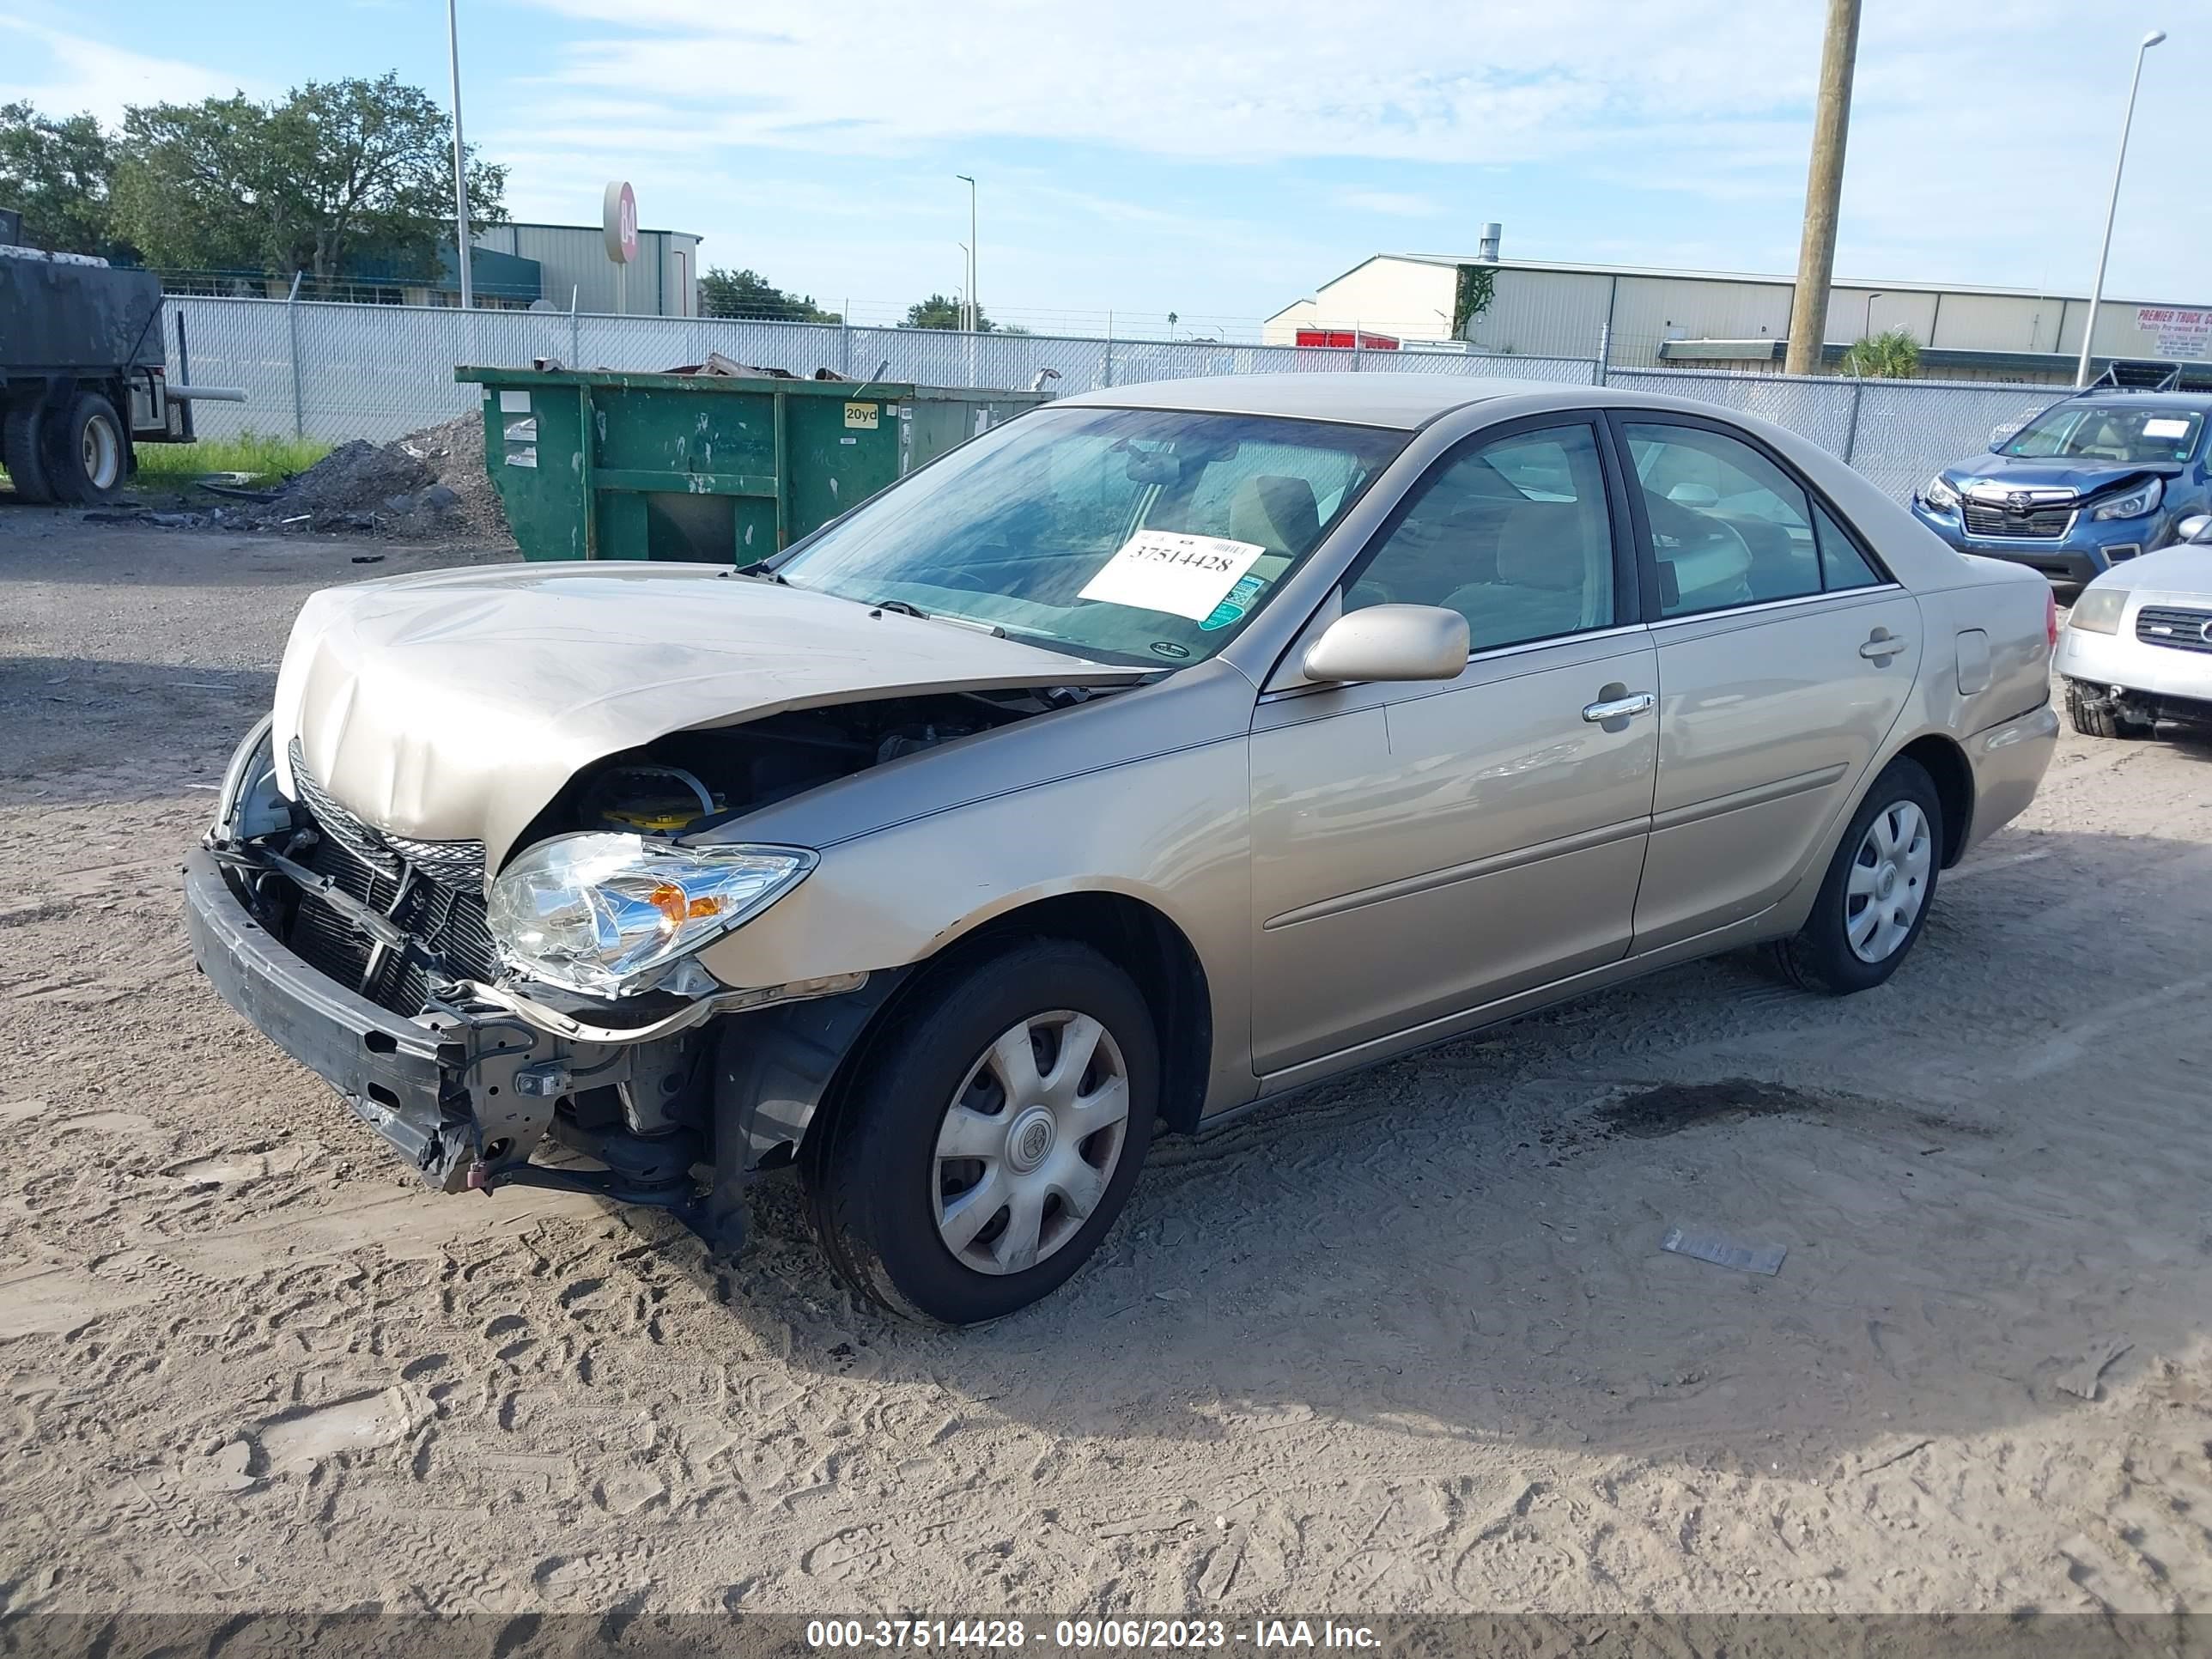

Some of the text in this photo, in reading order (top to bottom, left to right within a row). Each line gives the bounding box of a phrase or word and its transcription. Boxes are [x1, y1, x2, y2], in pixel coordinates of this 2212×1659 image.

[621, 199, 635, 246] 84
[2137, 309, 2175, 323] PREMIER
[2177, 311, 2203, 325] TRUCK
[846, 408, 878, 422] 20yd
[1129, 544, 1234, 573] 37514428
